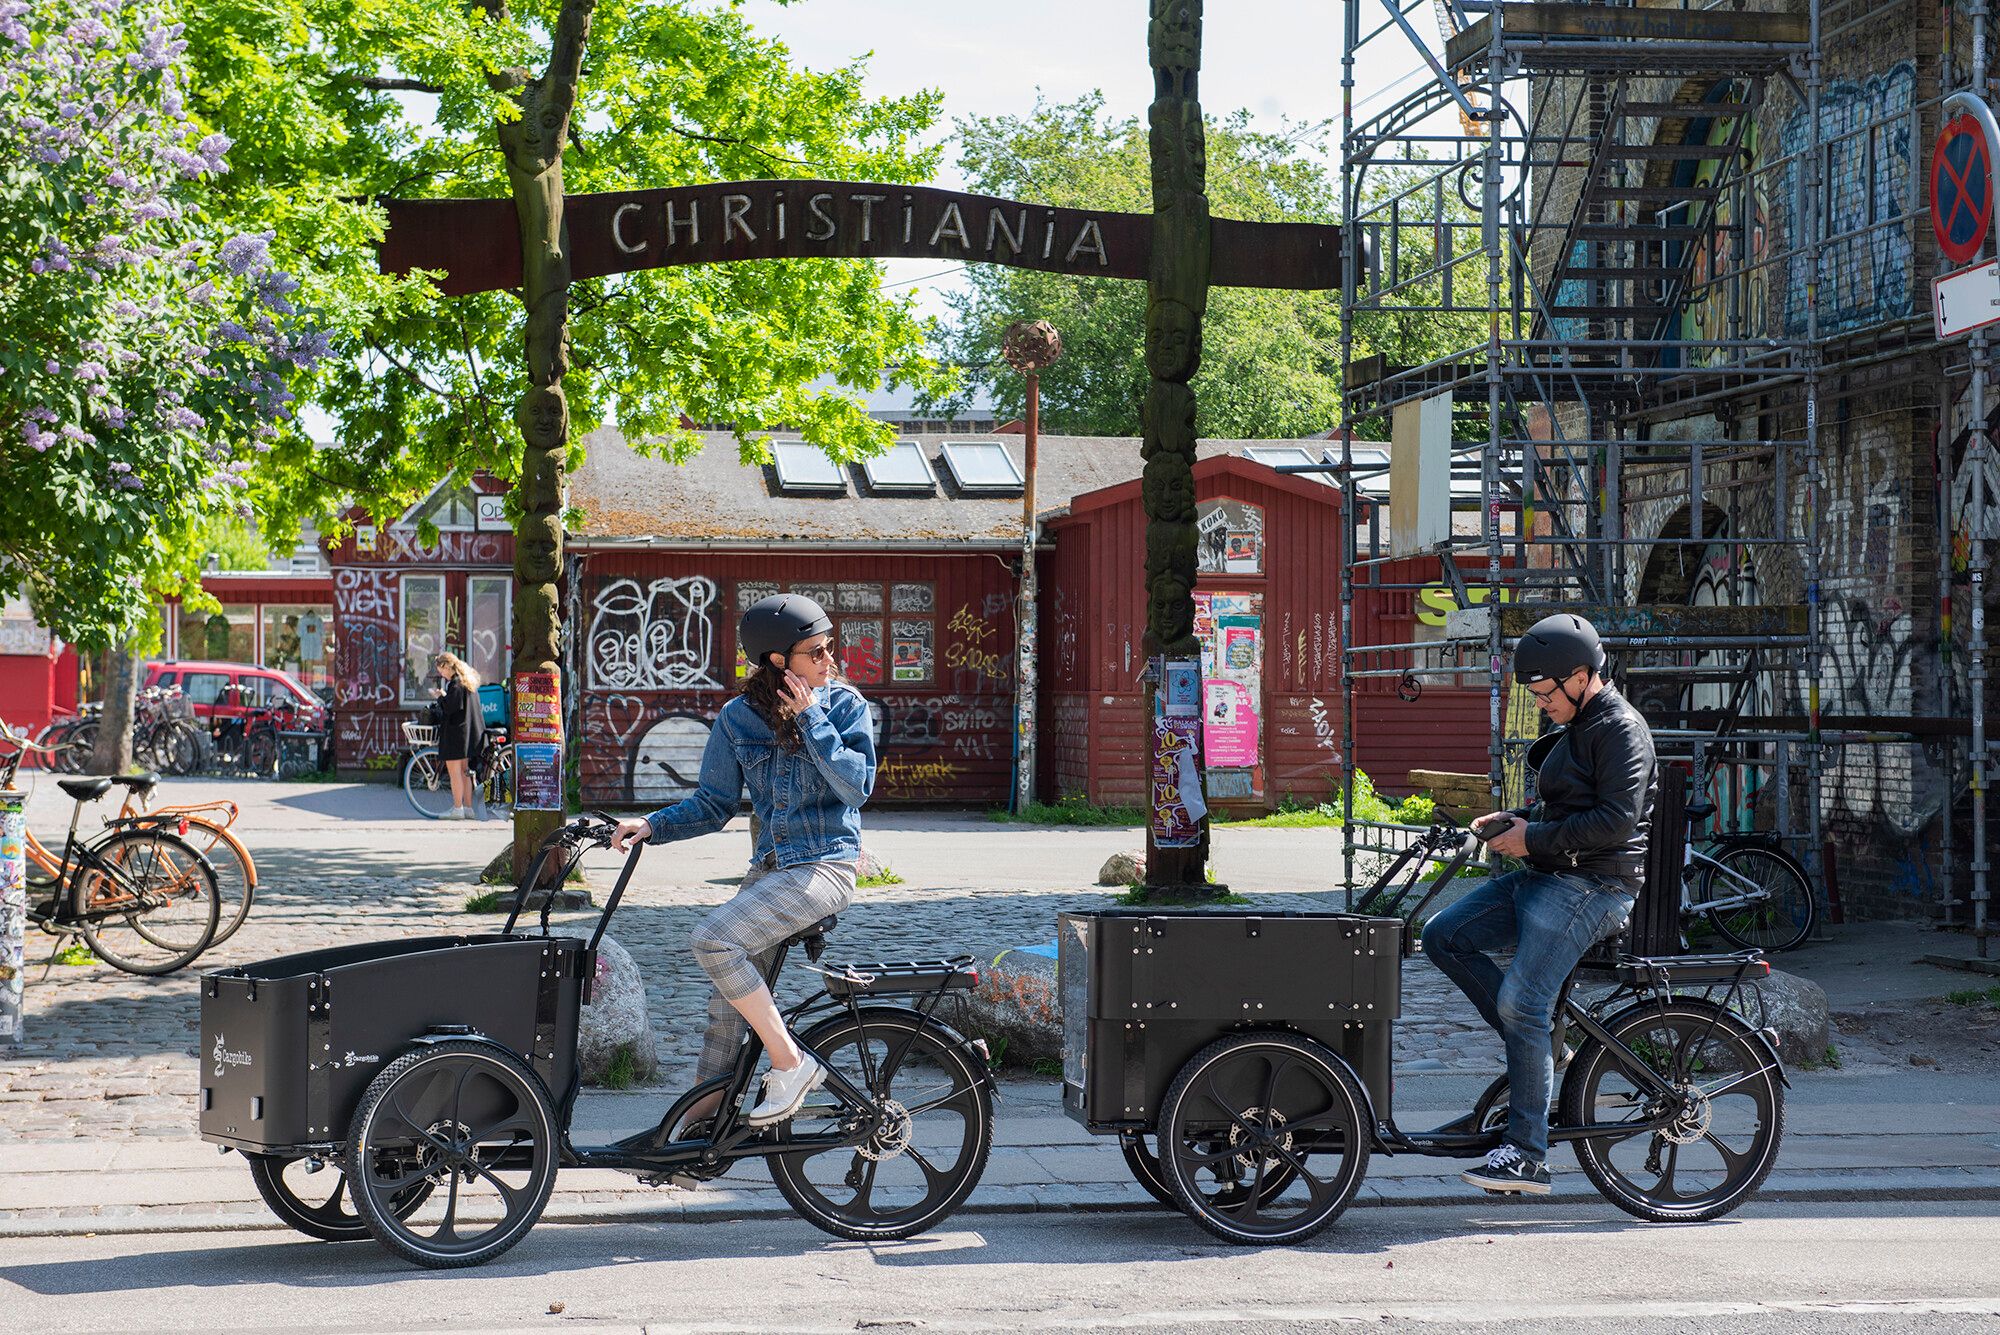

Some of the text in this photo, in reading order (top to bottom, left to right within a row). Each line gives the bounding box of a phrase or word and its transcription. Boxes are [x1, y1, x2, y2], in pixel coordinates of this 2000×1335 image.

[1200, 509, 1225, 532] KOKO
[1629, 637, 1648, 645] FONT
[1161, 731, 1176, 748] 10
[223, 1049, 252, 1067] Cargobike
